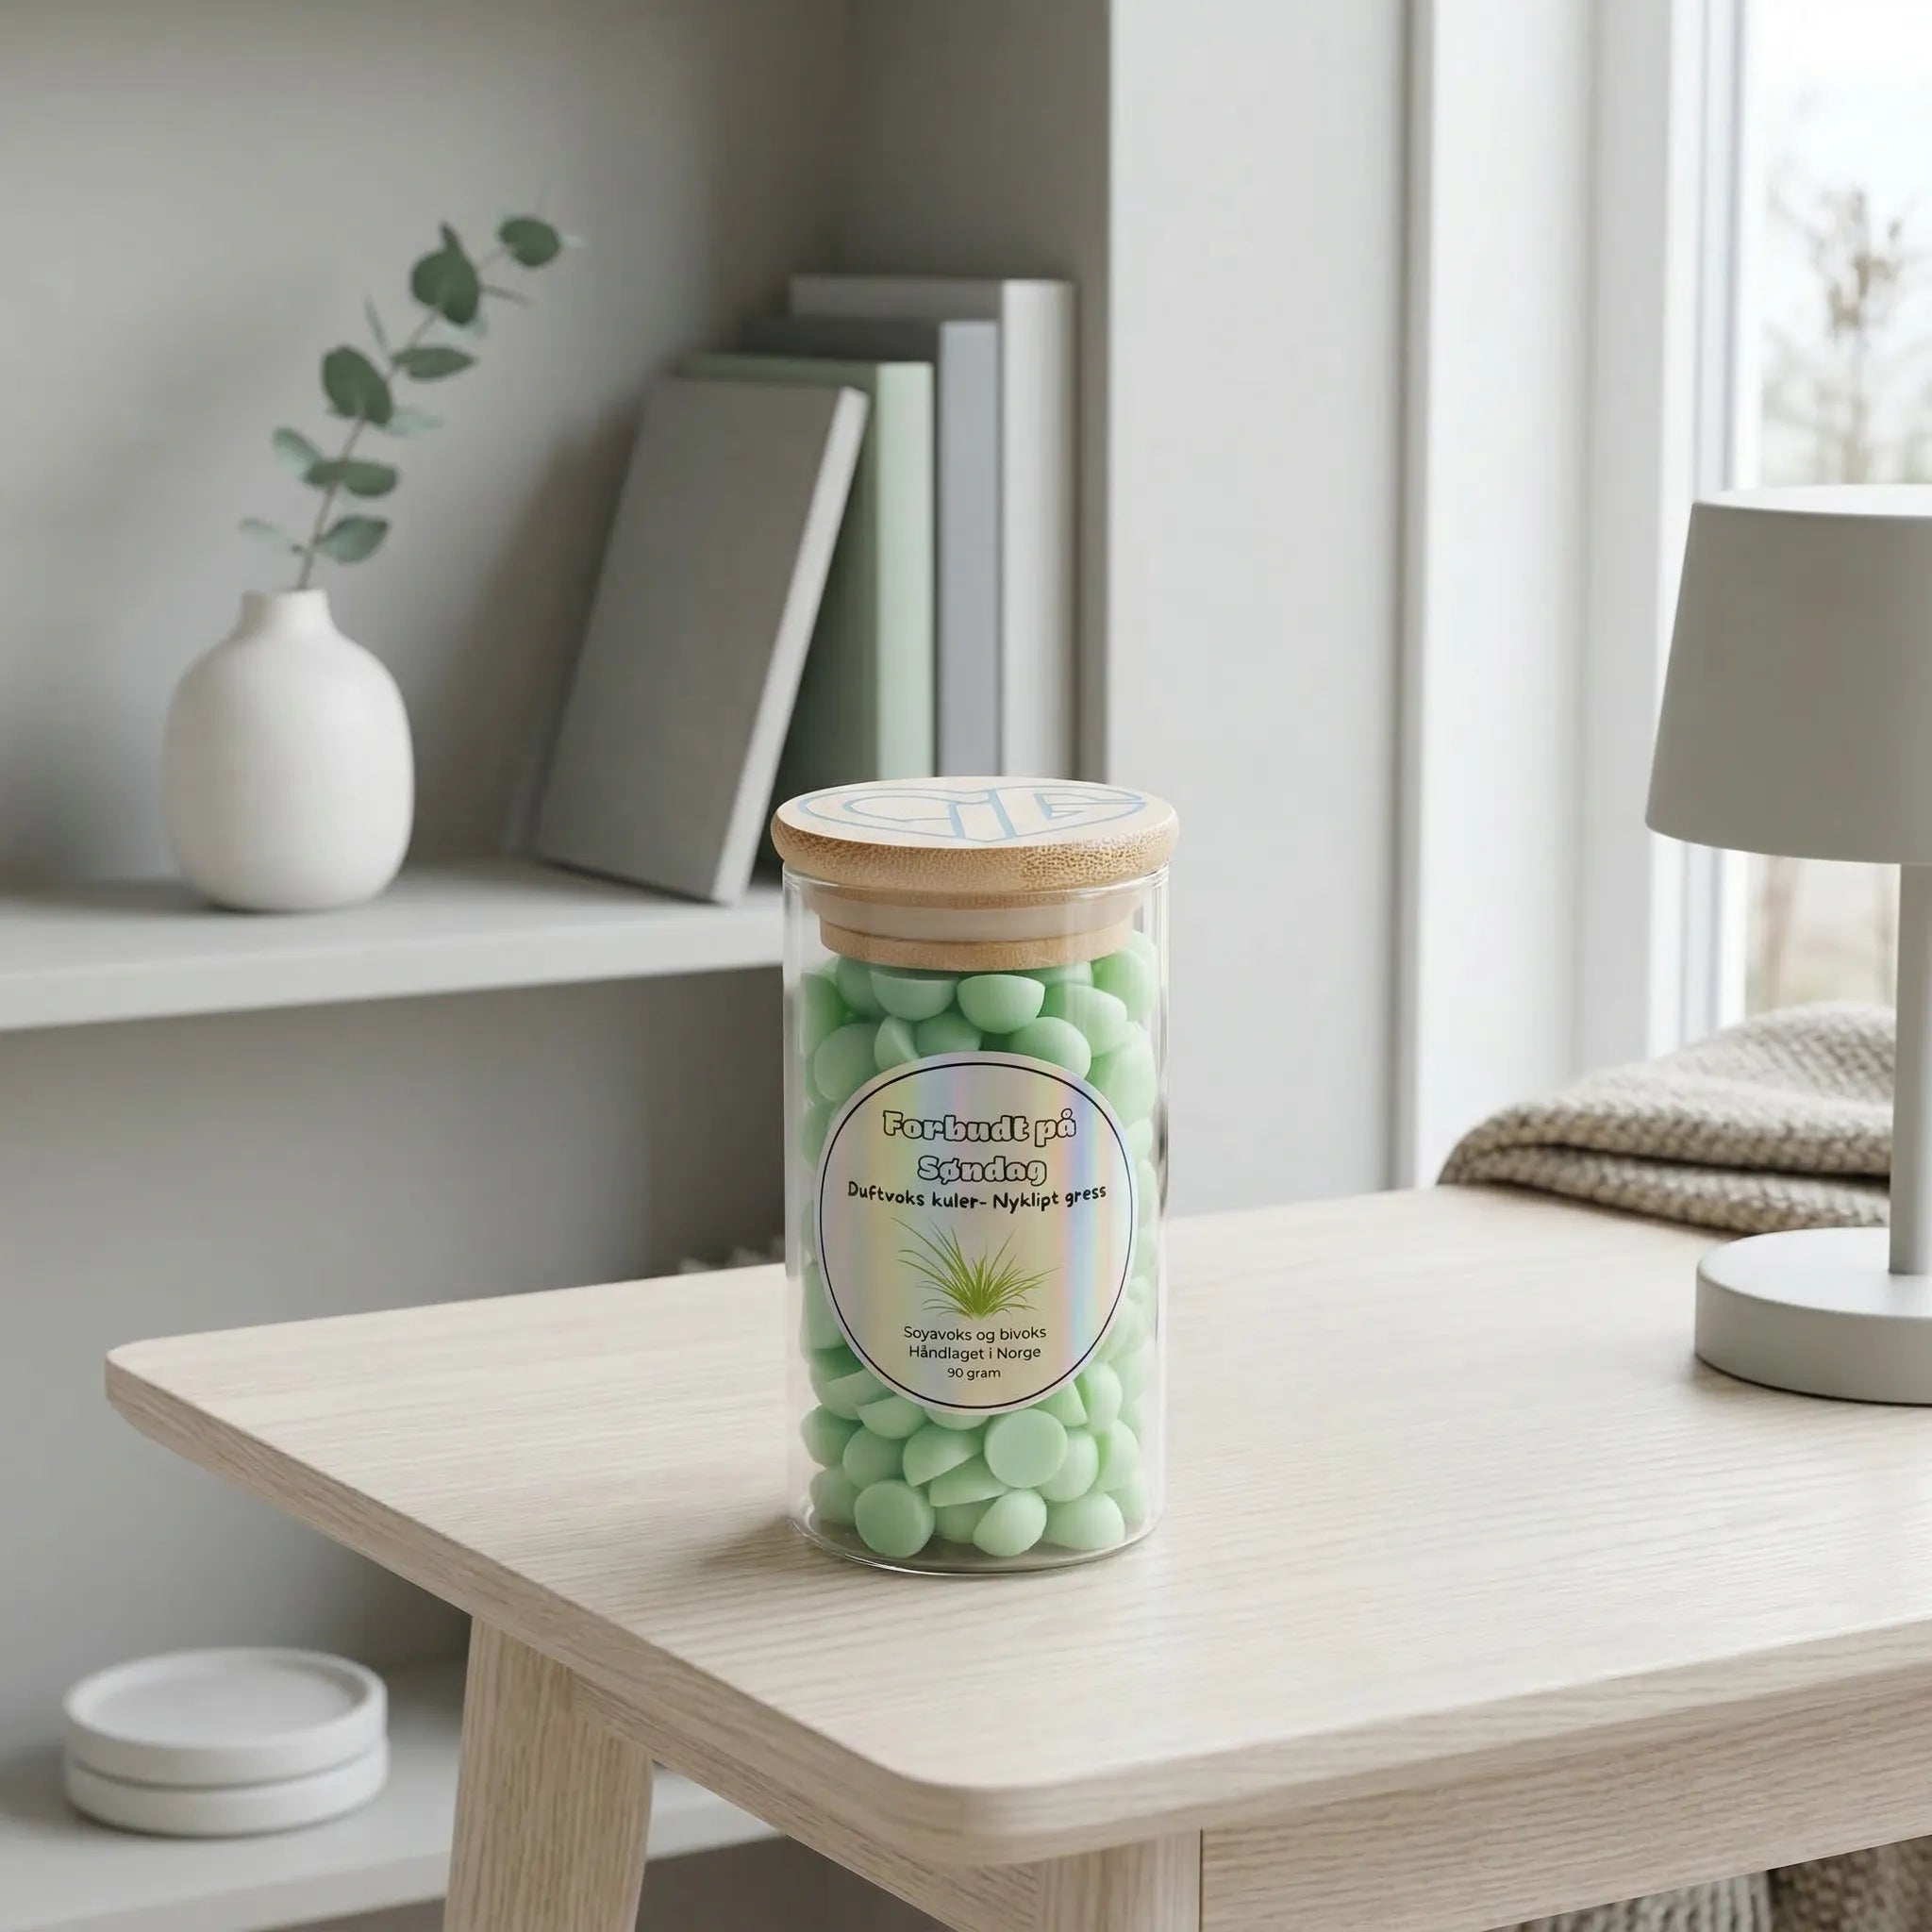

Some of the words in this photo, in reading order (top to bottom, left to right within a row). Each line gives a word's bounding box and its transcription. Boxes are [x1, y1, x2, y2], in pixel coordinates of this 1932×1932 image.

[883, 1109, 1030, 1142] Forbudt
[1034, 1108, 1076, 1148] på
[917, 1155, 1047, 1187] Søndag
[848, 1180, 925, 1207] Duftvoks
[932, 1190, 987, 1209] kuler-
[993, 1191, 1058, 1214] Nyklipt
[1065, 1186, 1107, 1208] gress
[904, 1325, 972, 1342] Soyavoks
[975, 1331, 995, 1343] og
[1000, 1325, 1047, 1341] bivoks
[908, 1345, 985, 1362] Håndlaget
[989, 1348, 992, 1359] i
[997, 1347, 1041, 1360] Norge
[947, 1367, 964, 1378] 90
[967, 1369, 1001, 1380] gram
